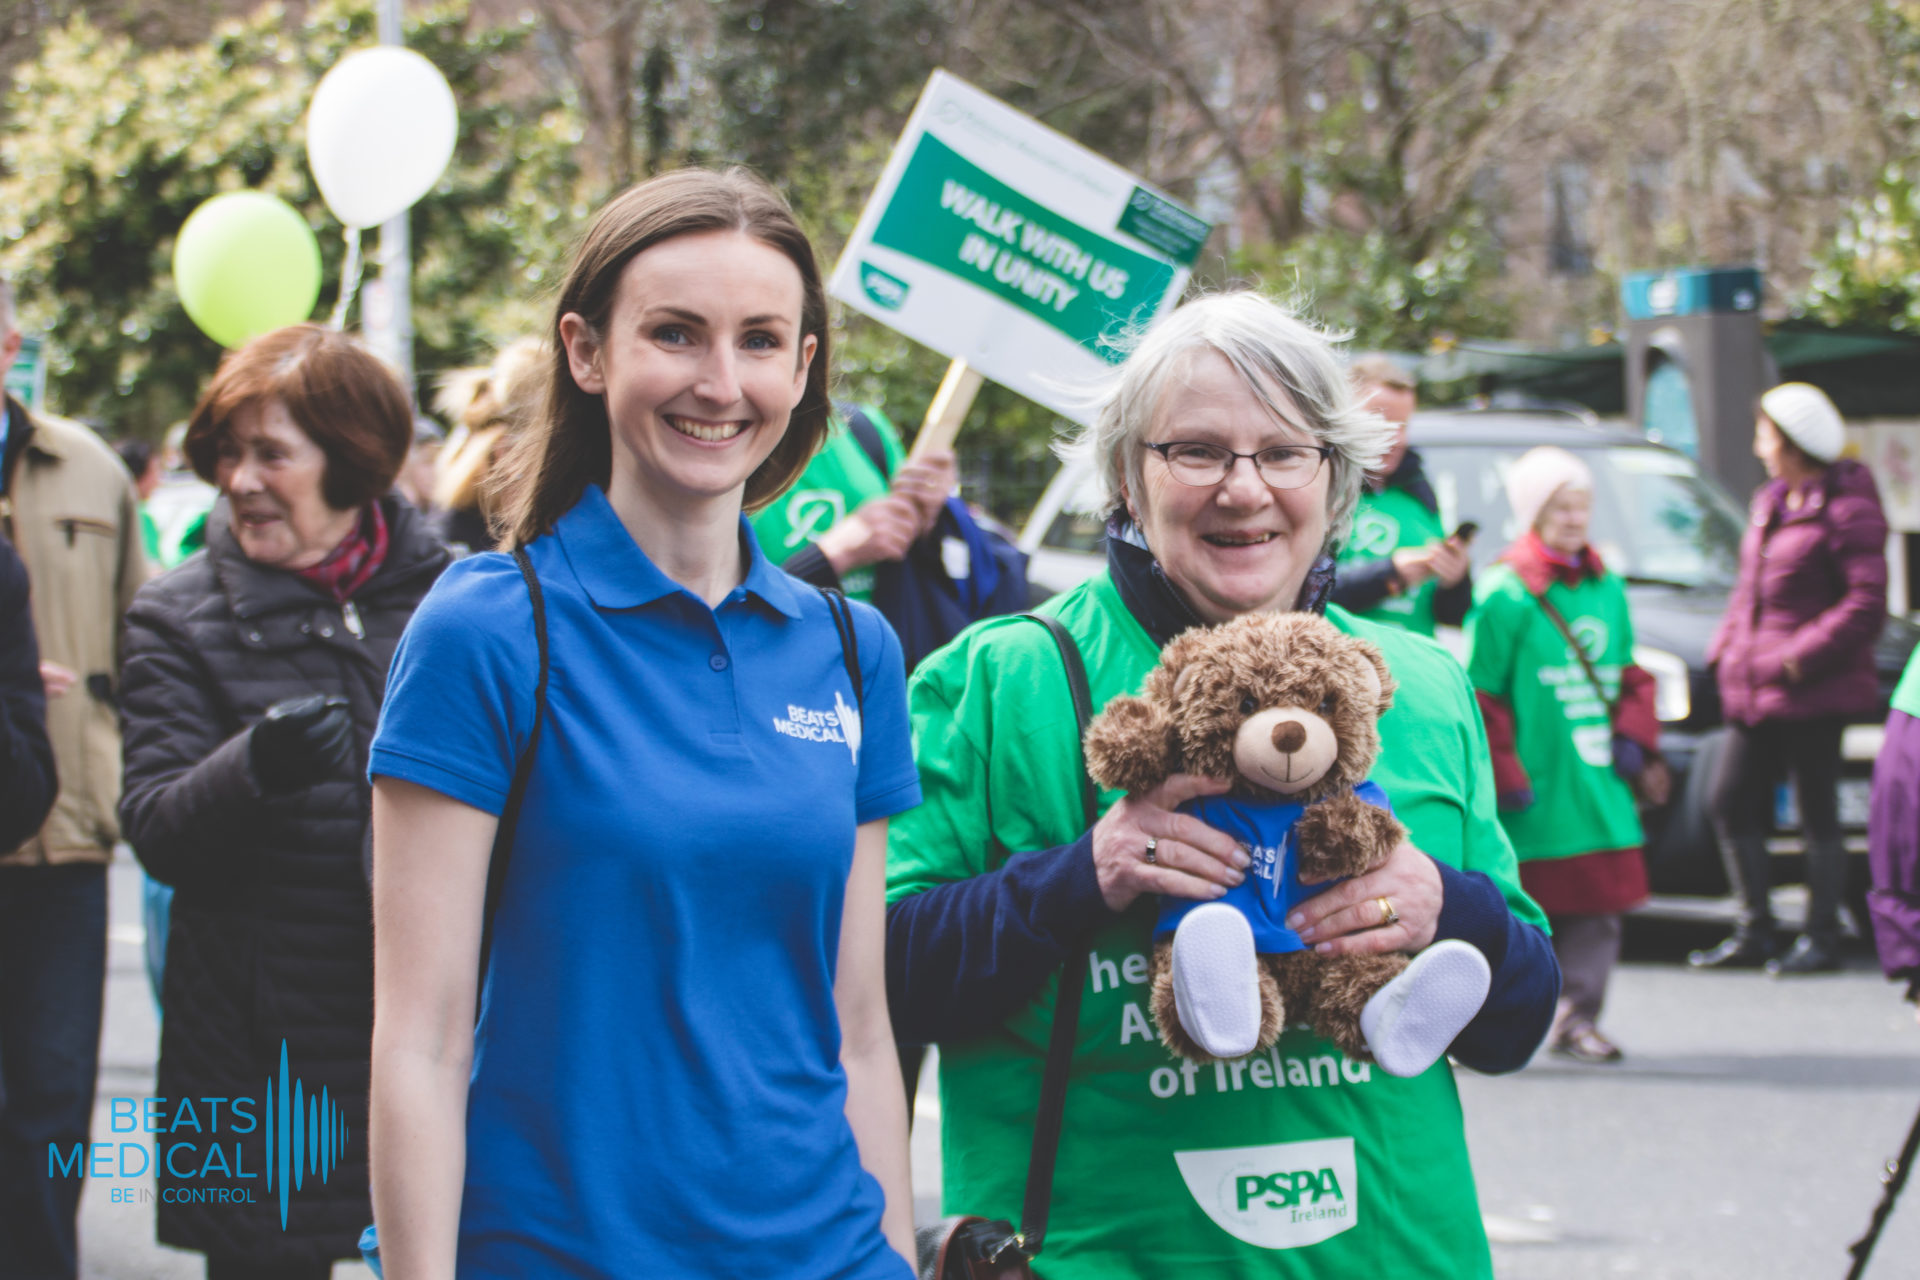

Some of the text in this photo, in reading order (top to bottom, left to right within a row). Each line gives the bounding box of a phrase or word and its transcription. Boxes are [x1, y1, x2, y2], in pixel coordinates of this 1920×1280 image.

[940, 178, 1022, 245] WALK
[1018, 222, 1093, 281] WITH
[1087, 260, 1131, 300] US
[957, 232, 1080, 313] IN UNITY
[773, 717, 847, 743] MEDICAL
[787, 704, 840, 727] BEATS
[1235, 1166, 1345, 1213] PSPA
[1290, 1202, 1348, 1224] Ireland
